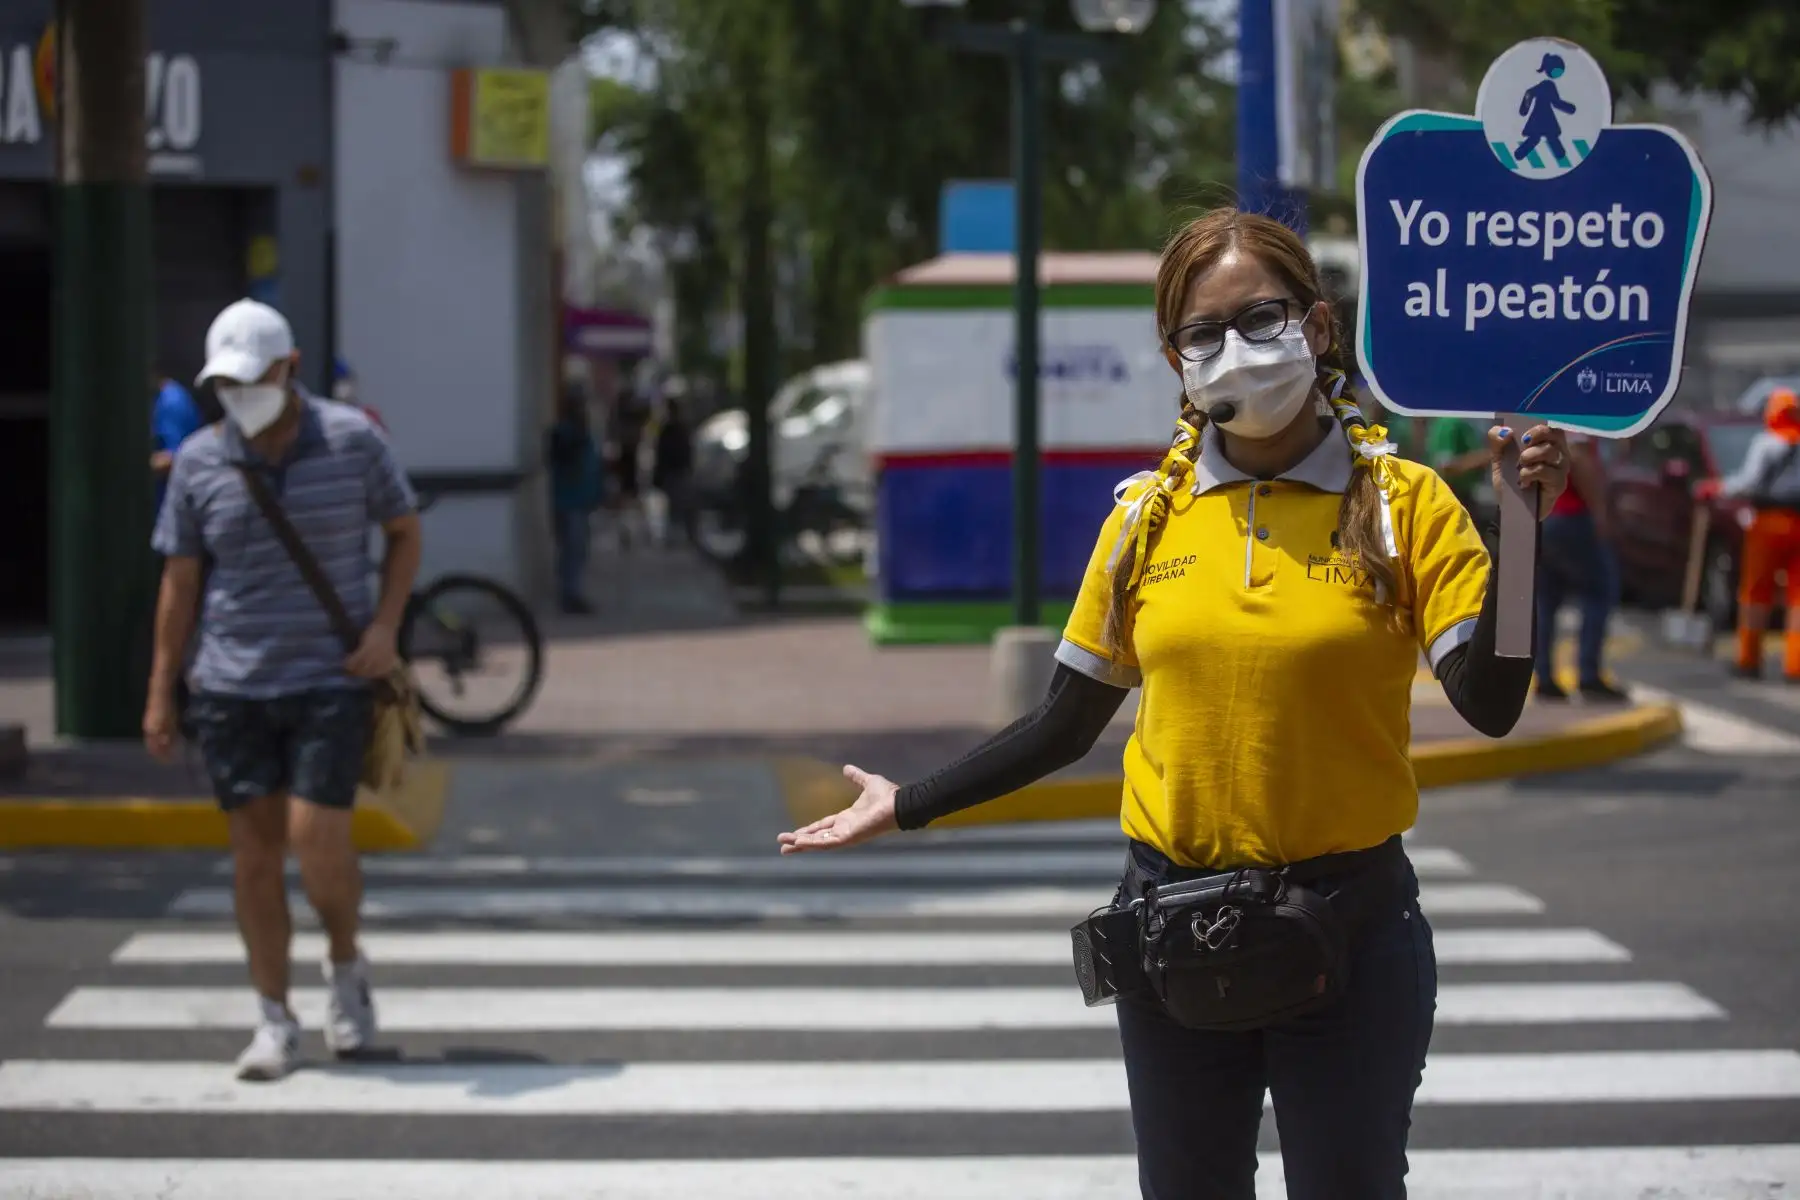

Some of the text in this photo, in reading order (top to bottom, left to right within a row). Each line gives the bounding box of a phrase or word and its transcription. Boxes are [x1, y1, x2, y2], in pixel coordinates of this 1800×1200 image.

[1389, 199, 1665, 260] Yo respeto
[1404, 268, 1649, 331] al peatón
[1606, 379, 1653, 394] LIMA
